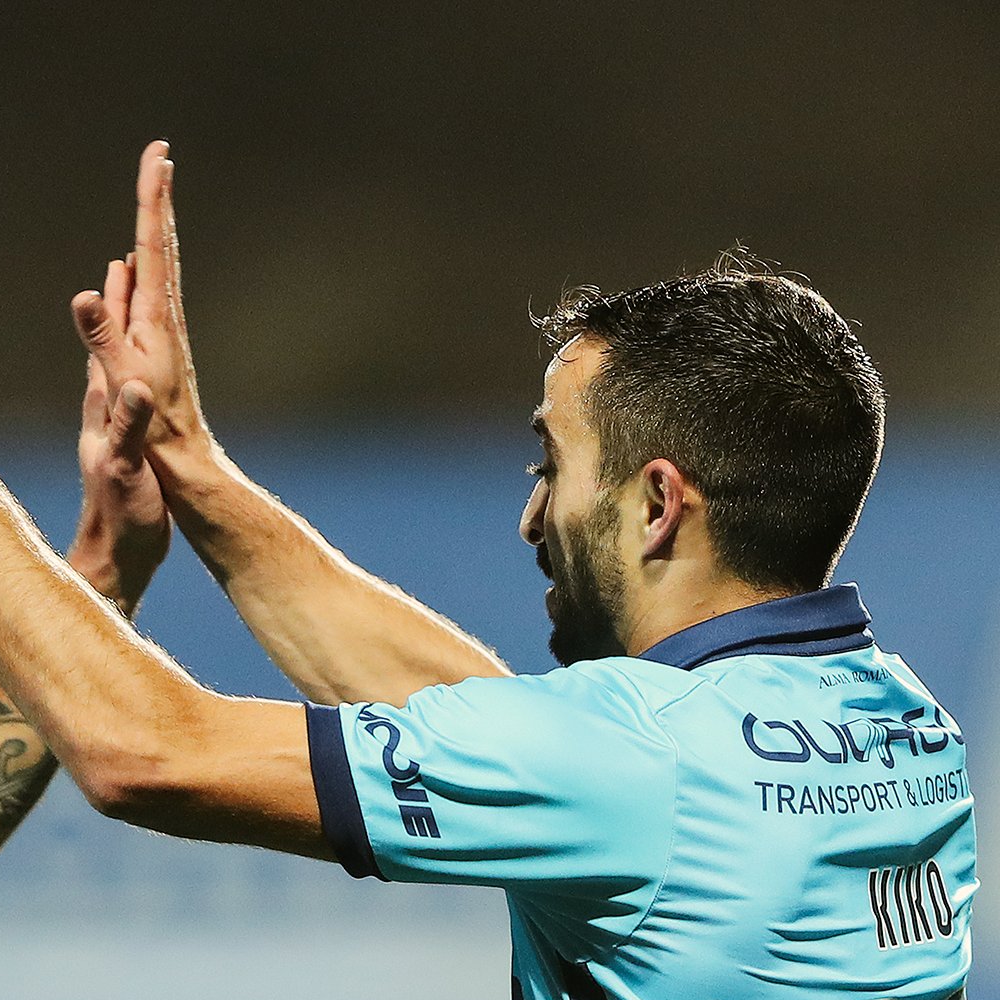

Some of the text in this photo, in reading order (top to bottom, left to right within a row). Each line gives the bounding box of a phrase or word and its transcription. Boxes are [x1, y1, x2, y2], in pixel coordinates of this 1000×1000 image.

[819, 673, 851, 689] ALMA
[754, 780, 903, 815] TRANSPORT
[903, 778, 919, 808] &
[867, 858, 954, 951] KIKO
